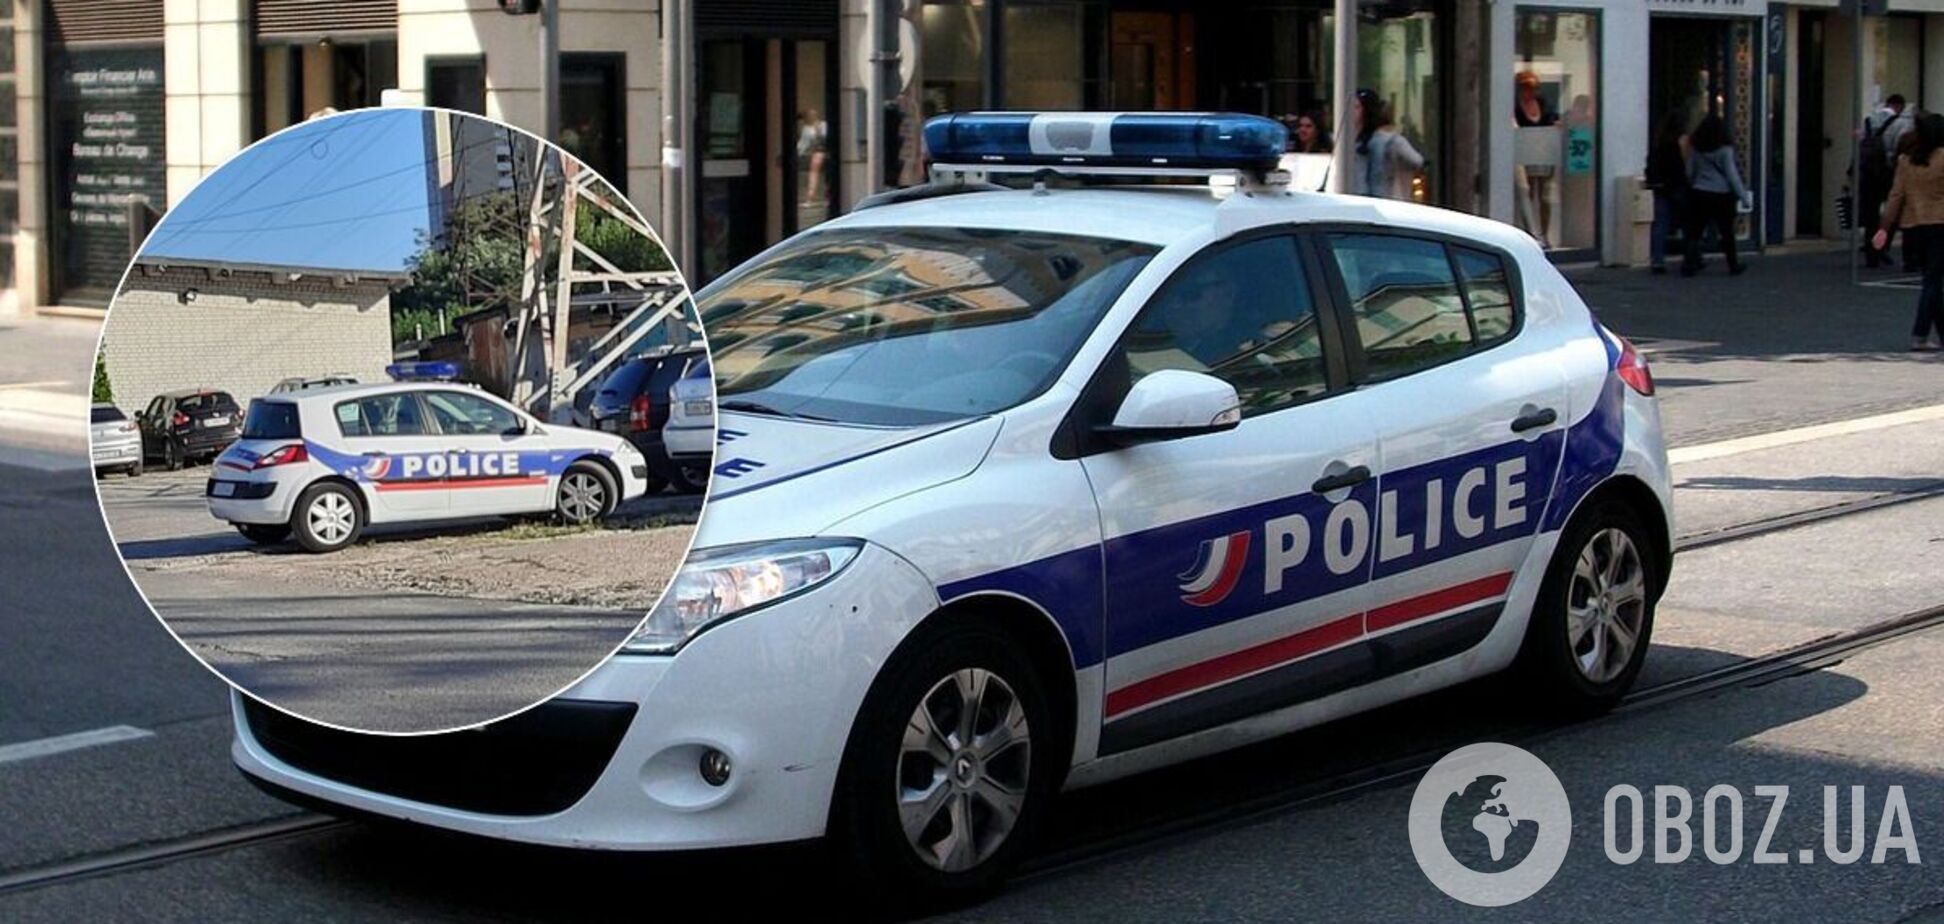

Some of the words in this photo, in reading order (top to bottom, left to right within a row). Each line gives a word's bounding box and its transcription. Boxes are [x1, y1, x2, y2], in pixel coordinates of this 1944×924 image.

[72, 142, 102, 157] Bureau
[116, 142, 149, 160] Change
[403, 453, 519, 478] POLICE
[1264, 456, 1528, 594] POLICE
